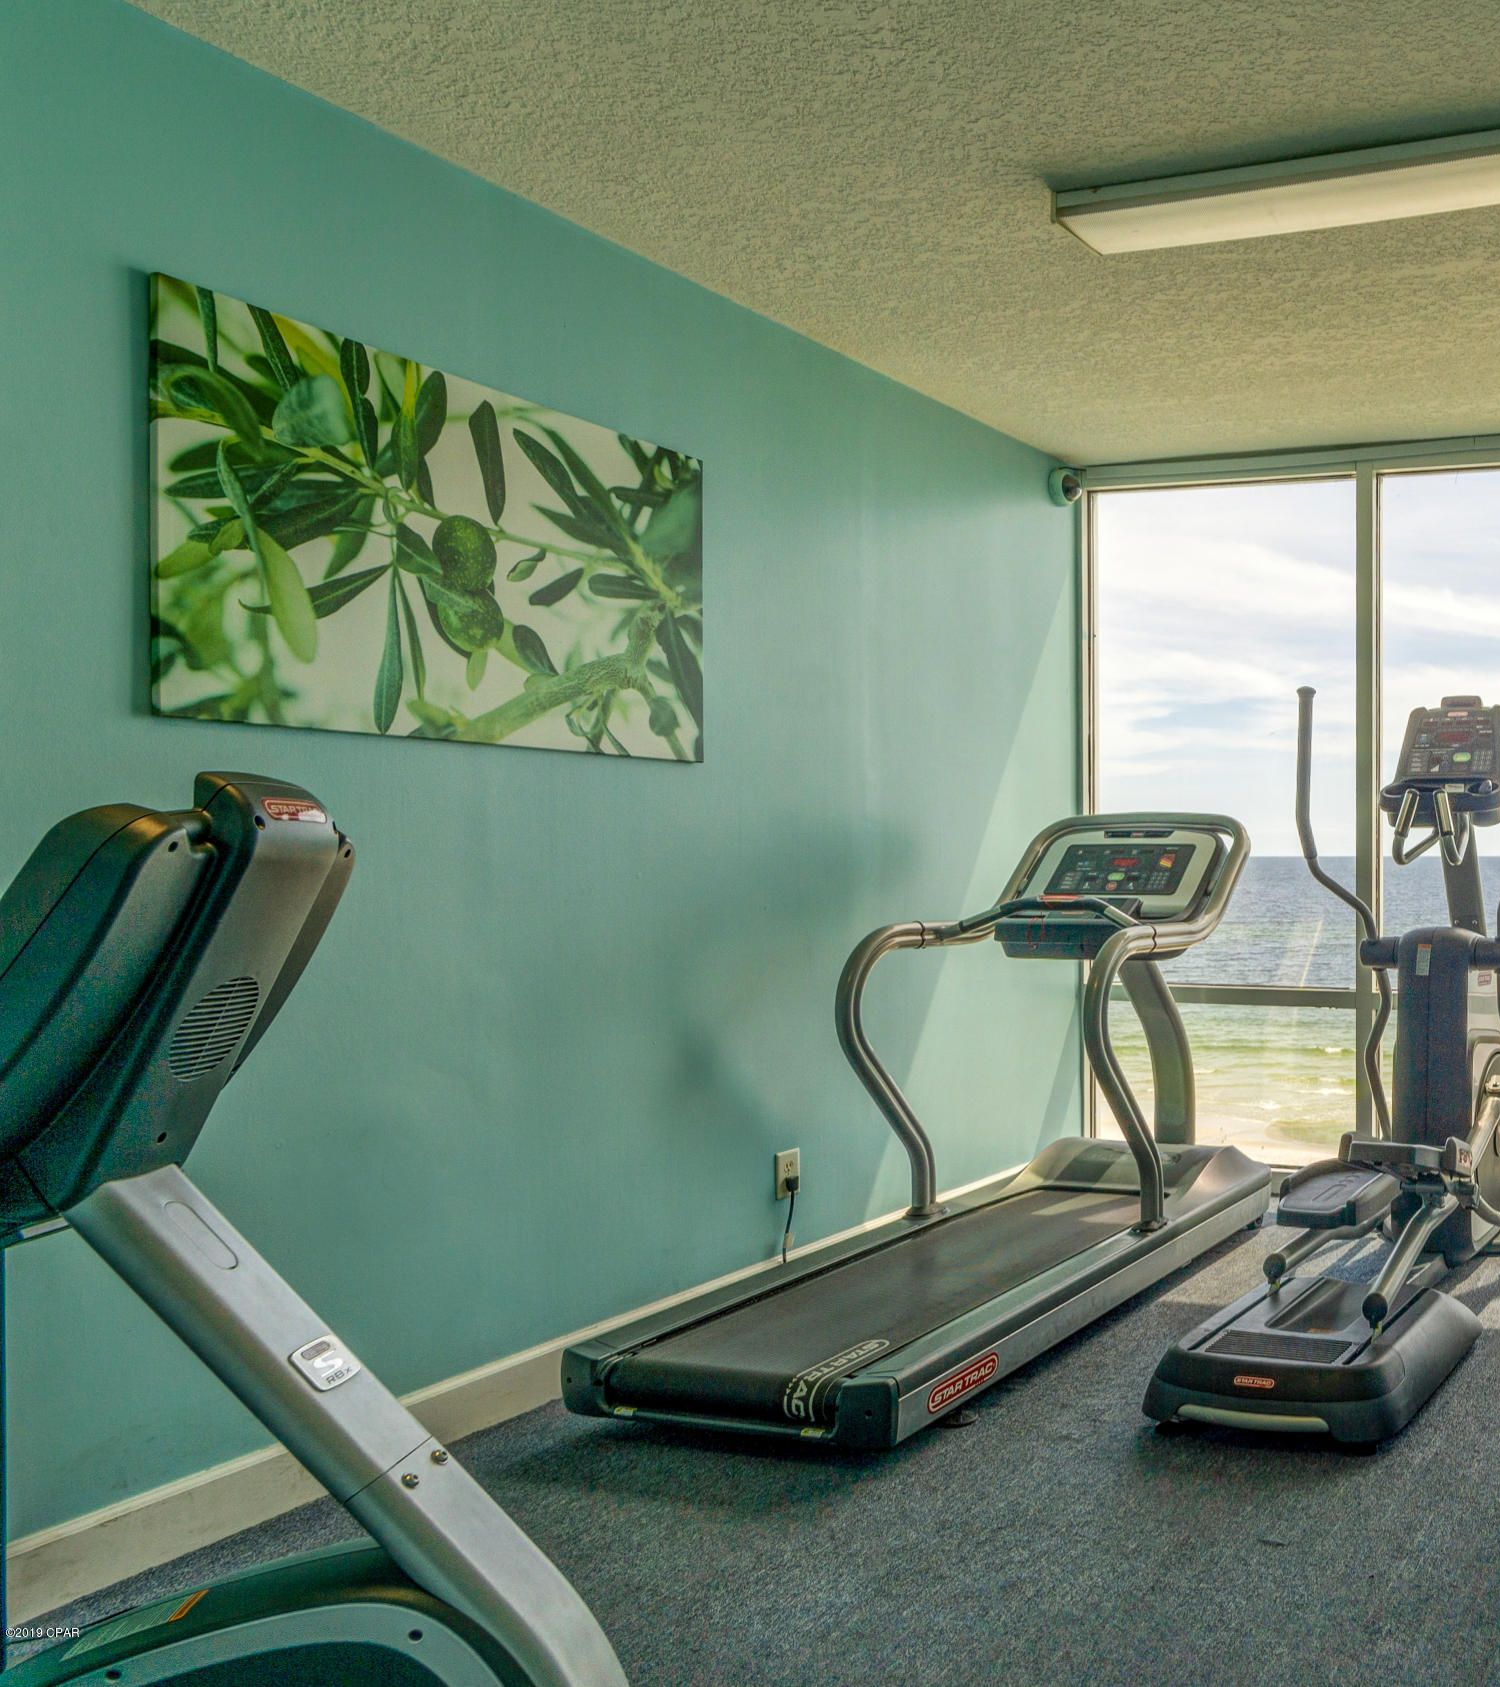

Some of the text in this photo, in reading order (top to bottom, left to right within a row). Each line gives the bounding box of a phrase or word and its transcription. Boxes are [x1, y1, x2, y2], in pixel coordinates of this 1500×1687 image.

[270, 804, 297, 813] STAR
[830, 1340, 880, 1367] STAR
[930, 1361, 994, 1407] STAR TRAC
